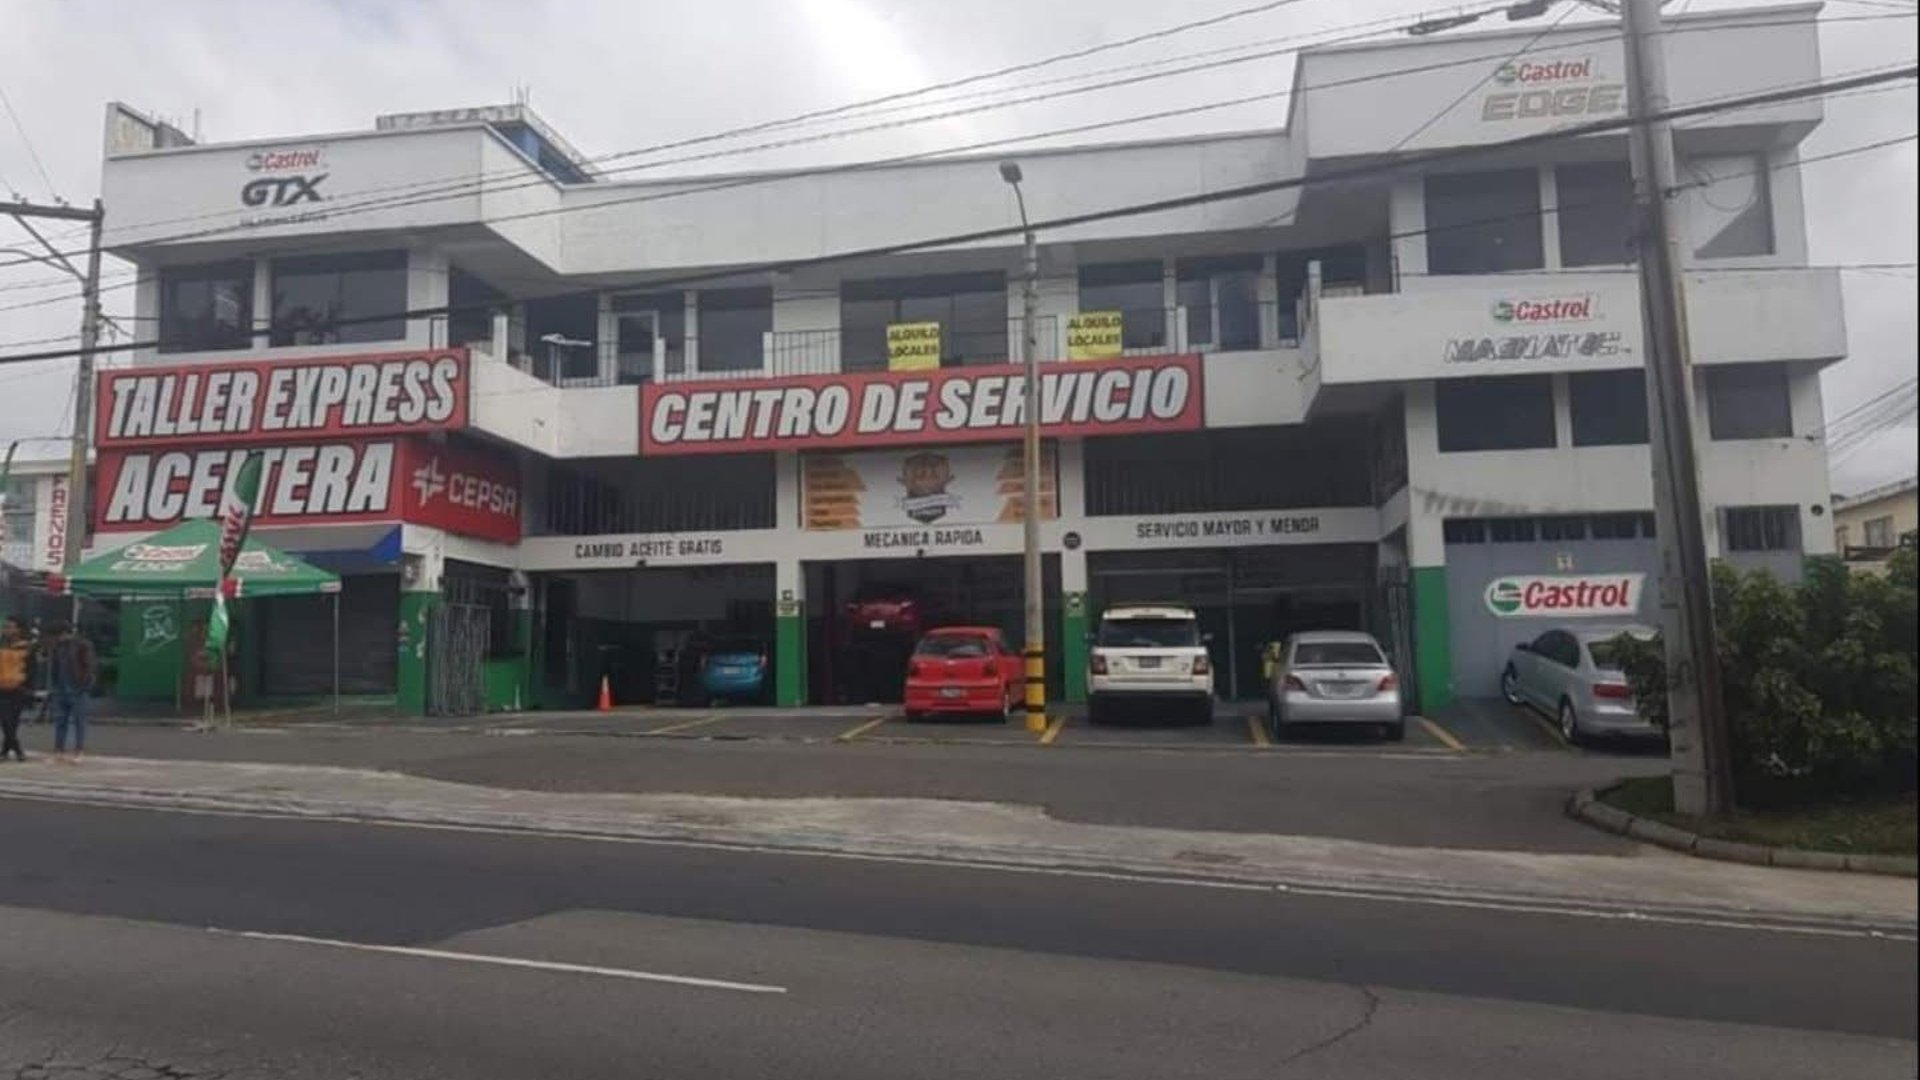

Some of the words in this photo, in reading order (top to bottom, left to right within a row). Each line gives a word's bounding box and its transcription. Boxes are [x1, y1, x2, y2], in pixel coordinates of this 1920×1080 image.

[1518, 58, 1591, 82] Castrol
[1482, 84, 1623, 121] EDGE
[265, 150, 319, 169] Castrol
[242, 172, 330, 206] GTX
[1516, 298, 1591, 320] Castrol
[1067, 315, 1120, 329] ALQUILO
[890, 327, 938, 341] ALQUILO
[1068, 333, 1120, 347] LOCALES
[889, 345, 937, 358] LOCALES
[108, 369, 259, 438] TALLER
[261, 358, 458, 431] EXPRESS
[650, 384, 849, 443] CENTRO
[858, 380, 930, 433] DE
[936, 365, 1189, 429] SERVICIO
[449, 473, 518, 513] CEPSA
[1137, 522, 1197, 538] SERVICIO
[1203, 519, 1250, 536] MAYOR
[1256, 519, 1265, 534] Y
[1271, 516, 1319, 533] MENOR
[576, 543, 624, 558] CAMBIO
[630, 540, 672, 556] ACEITE
[679, 538, 722, 555] GRATIS
[864, 531, 929, 548] MECANICA
[935, 530, 983, 546] RAPIDA
[1525, 580, 1629, 609] Castrol
